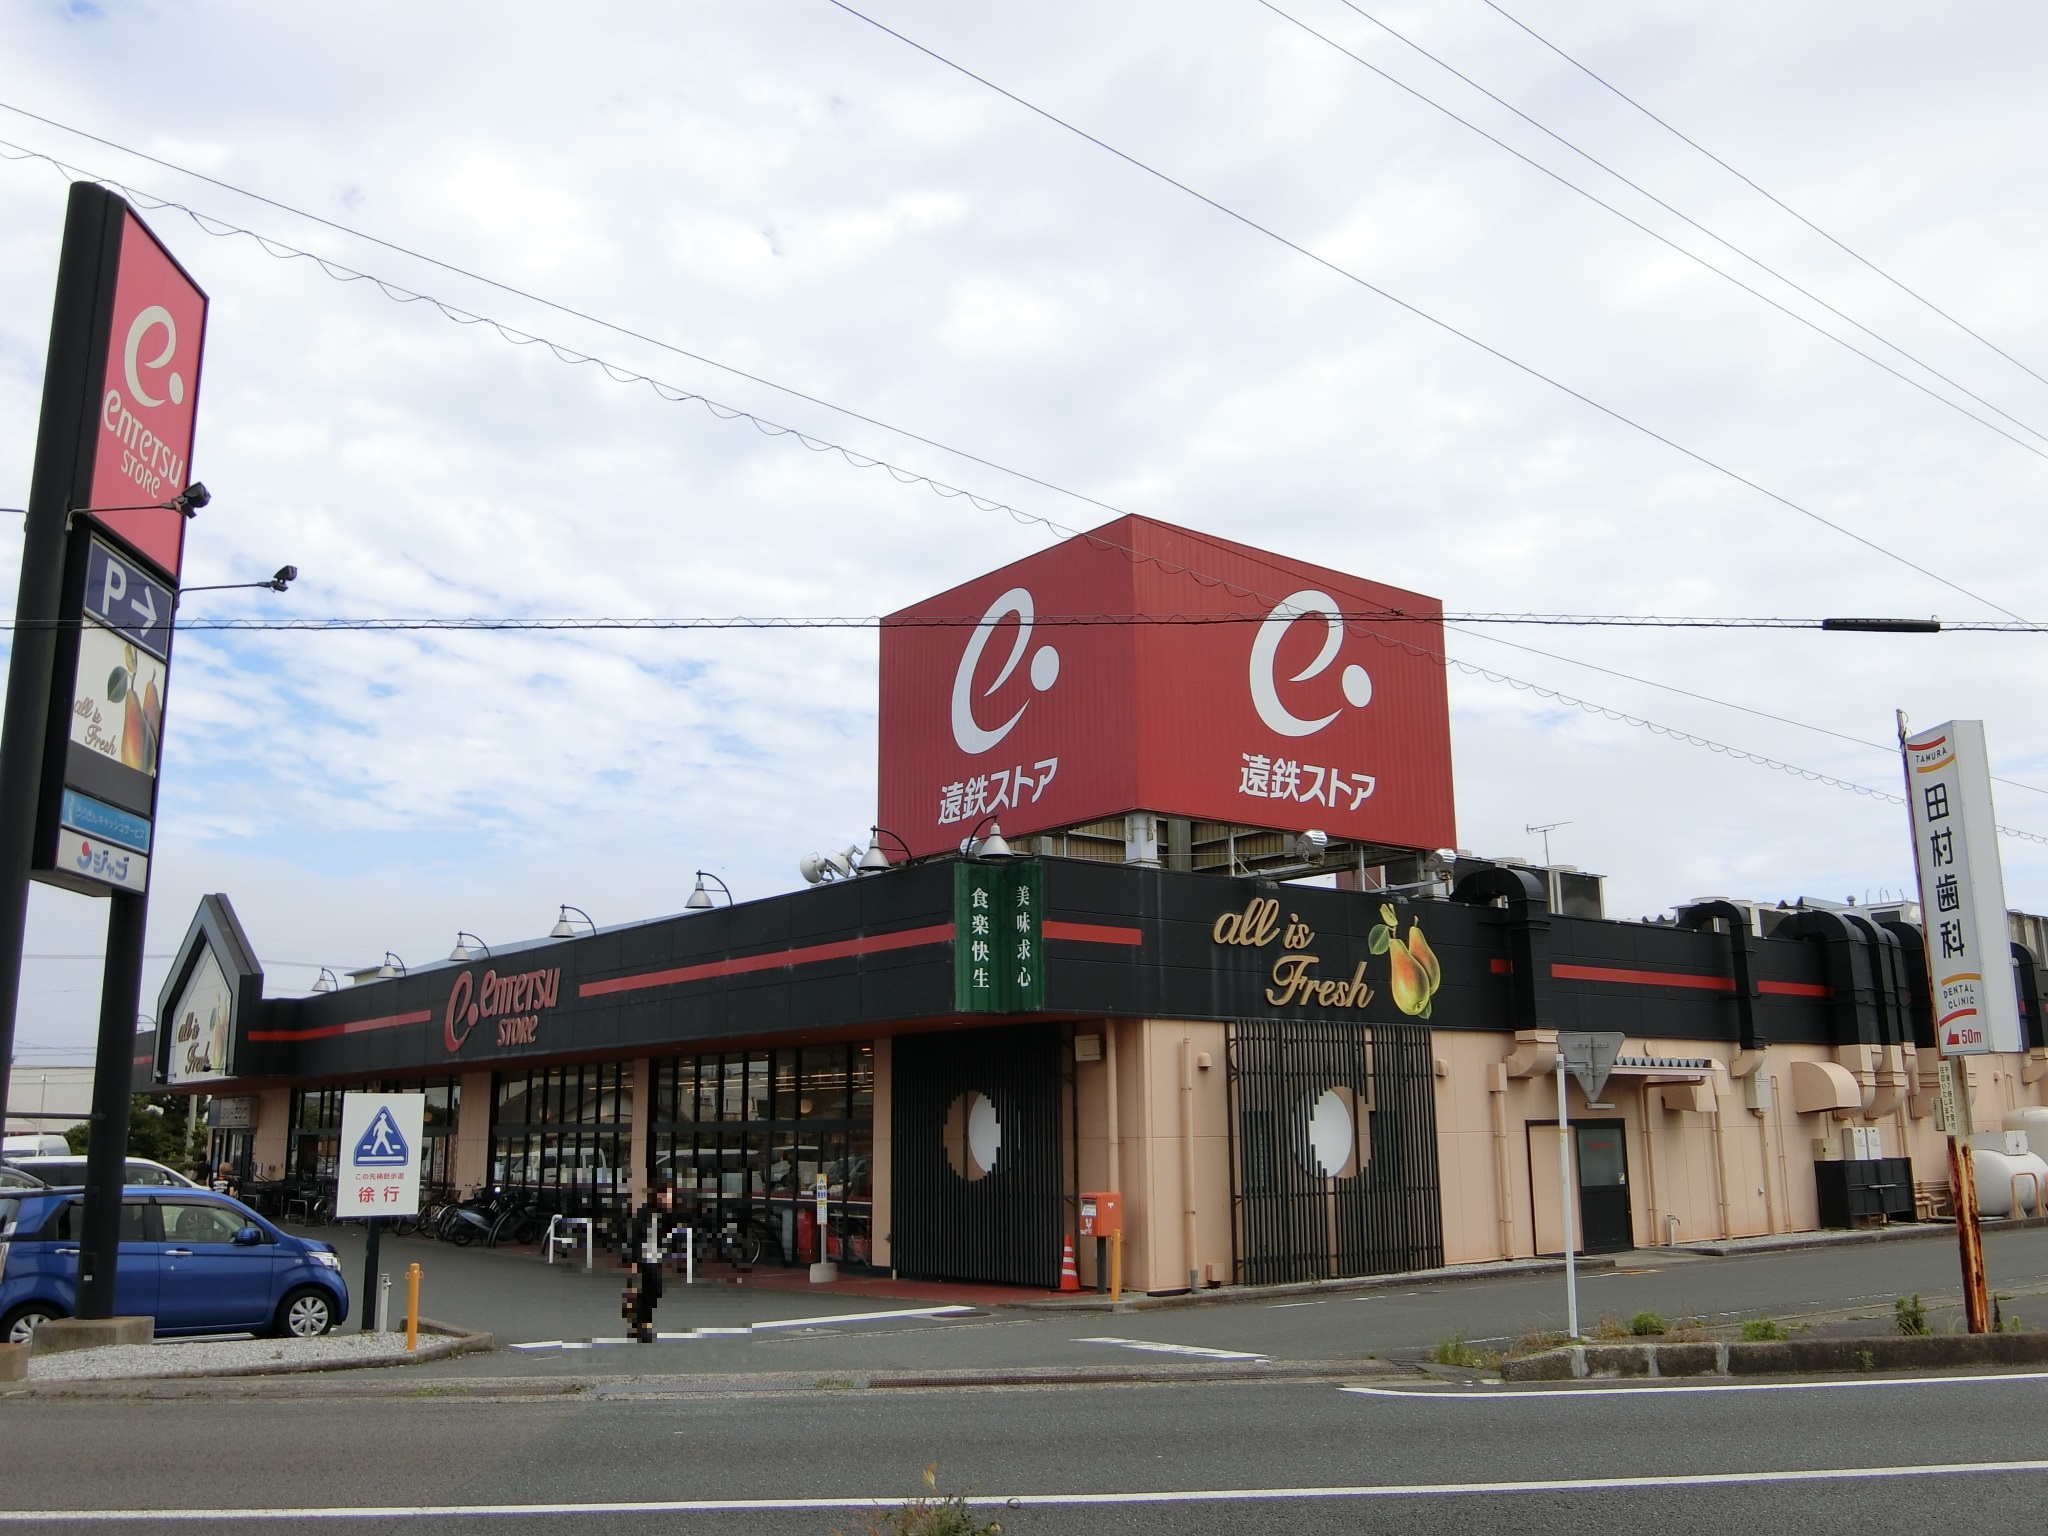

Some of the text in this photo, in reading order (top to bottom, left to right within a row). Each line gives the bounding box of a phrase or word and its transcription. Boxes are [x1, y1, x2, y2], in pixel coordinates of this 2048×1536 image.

[102, 557, 127, 617] P
[74, 696, 93, 719] all
[84, 723, 117, 756] Fresh
[1915, 747, 1948, 764] TAMURA
[937, 756, 1059, 826] 遠鉄ストア
[1238, 752, 1376, 811] 遠鉄ストア
[1924, 782, 1966, 959] 田村歯科
[971, 887, 990, 988] 食楽快生
[1016, 885, 1032, 987] 美味求心
[1212, 897, 1316, 950] all is
[1265, 954, 1376, 1010] Fresh
[1943, 984, 1975, 999] DENTAL
[1948, 997, 1975, 1010] CLINIC
[1961, 1028, 1983, 1045] 50m
[355, 1172, 405, 1181] この先横断歩道
[358, 1185, 400, 1204] 徐行
